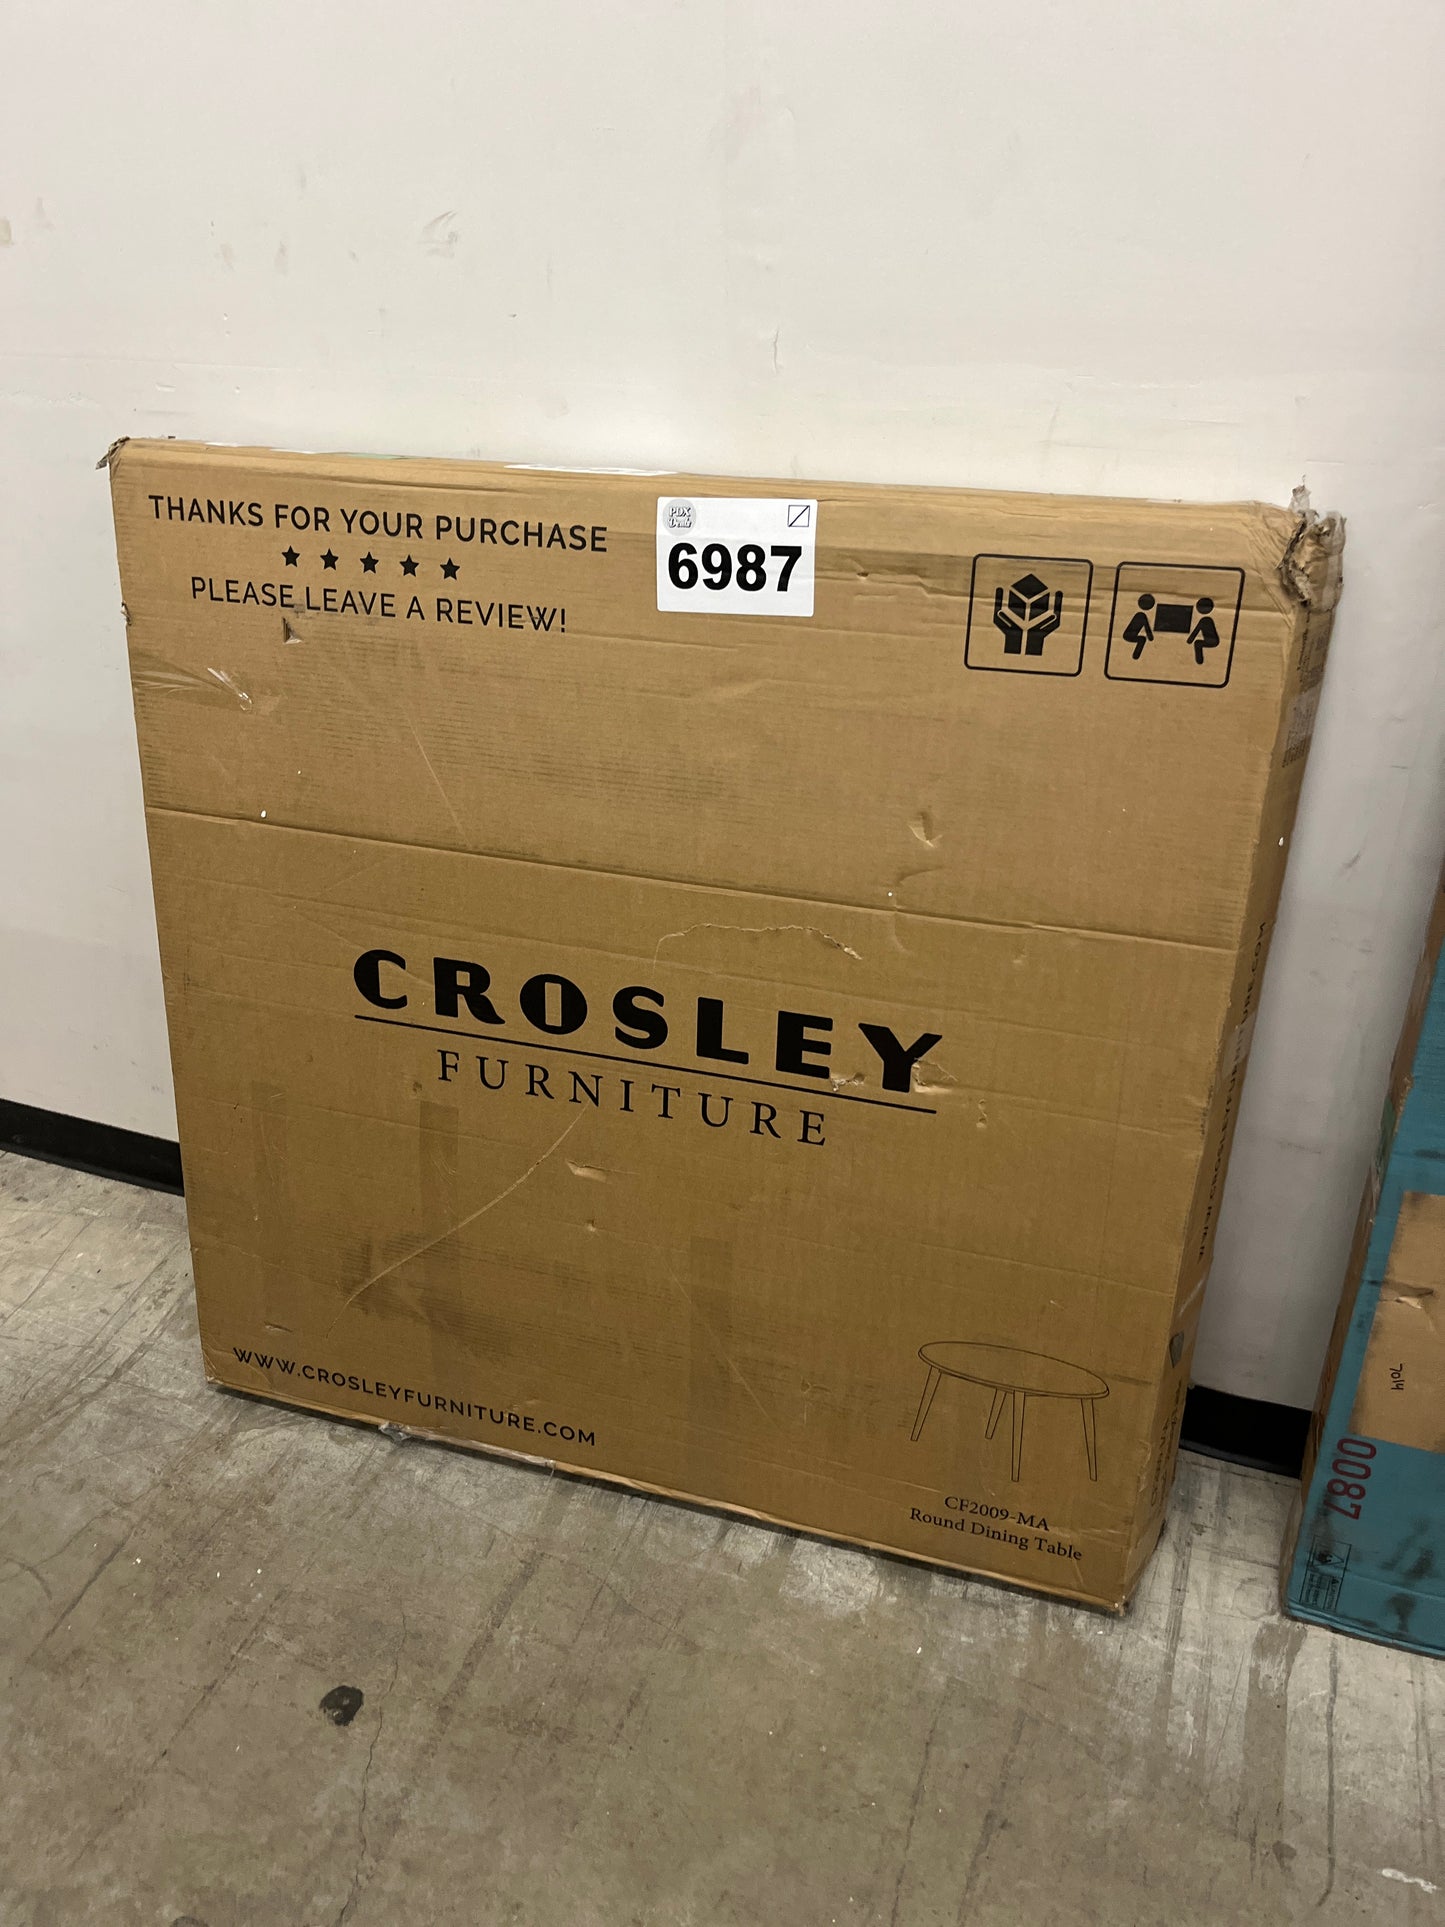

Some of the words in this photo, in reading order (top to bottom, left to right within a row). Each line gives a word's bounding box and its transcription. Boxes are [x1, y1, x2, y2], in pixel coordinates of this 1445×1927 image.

[148, 494, 264, 528] THANKS
[274, 503, 331, 532] FOR
[340, 508, 424, 540] YOUR
[435, 515, 608, 553] PURCHASE
[668, 542, 803, 592] 6987
[191, 576, 294, 609] PLEASE
[304, 586, 397, 618] LEAVE
[406, 595, 426, 621] A
[436, 599, 567, 633] REVIEW!
[353, 948, 943, 1094] CROSLEY
[437, 1049, 827, 1146] FURNITURE
[232, 1346, 597, 1446] WWW.CROSLEYFURNITURE.COM
[1322, 1437, 1378, 1521] 0087
[909, 1507, 966, 1532] Round
[970, 1521, 1029, 1551] Dining
[1034, 1536, 1083, 1561] Table
[944, 1496, 1051, 1532] CF2009-MA
